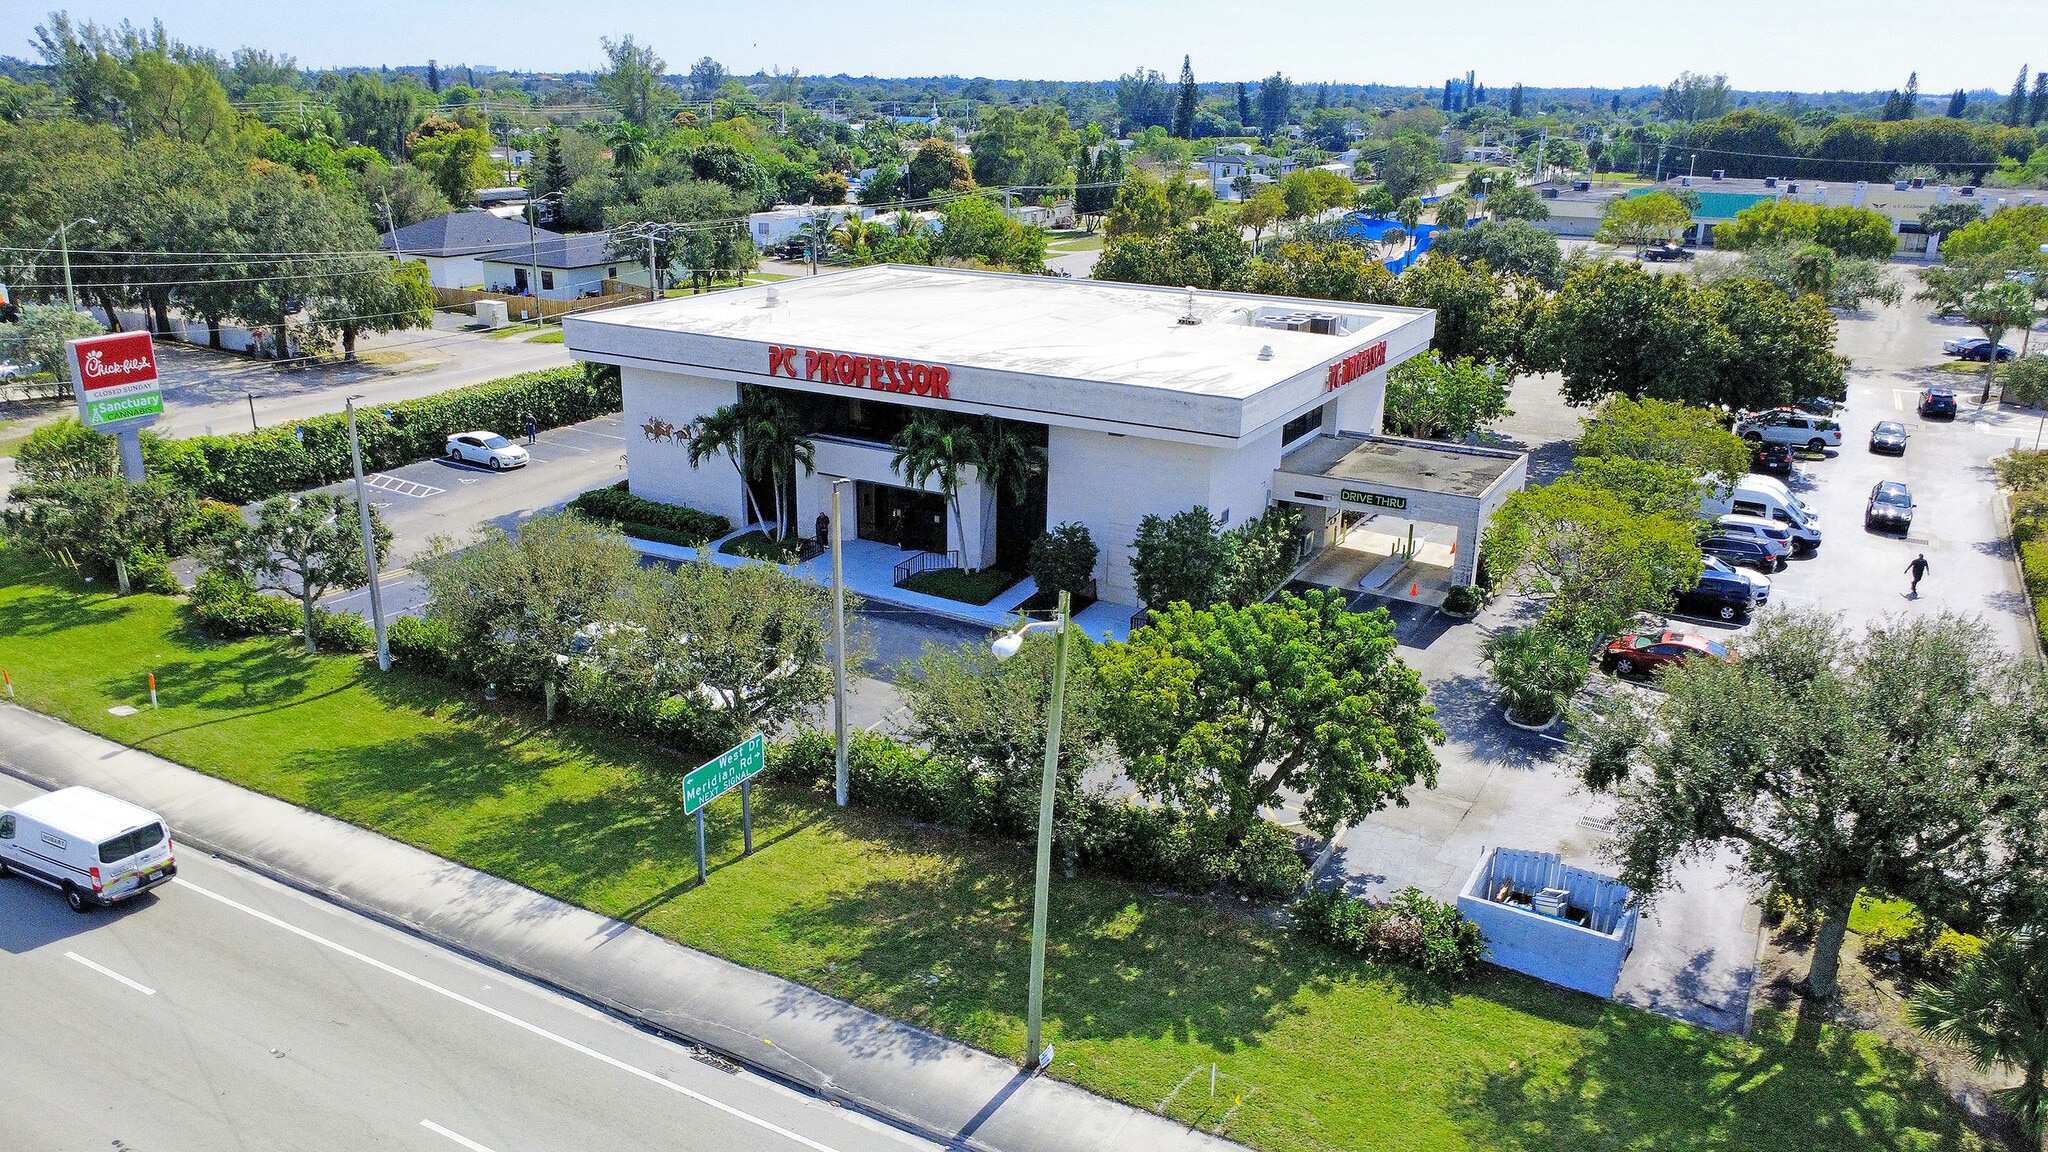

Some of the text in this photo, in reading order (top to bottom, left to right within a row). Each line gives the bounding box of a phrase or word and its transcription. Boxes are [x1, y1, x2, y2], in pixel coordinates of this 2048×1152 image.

[768, 345, 951, 399] PC PROFESSOR
[94, 382, 152, 397] CLOSED SUNDAY
[98, 395, 160, 413] Sanctuary
[107, 406, 153, 420] CANNABIS
[1342, 491, 1405, 509] DRIVE THRU
[719, 738, 760, 769] West Dr
[686, 754, 753, 802] Meridian Rd
[698, 769, 750, 805] NEXT SIGNAL
